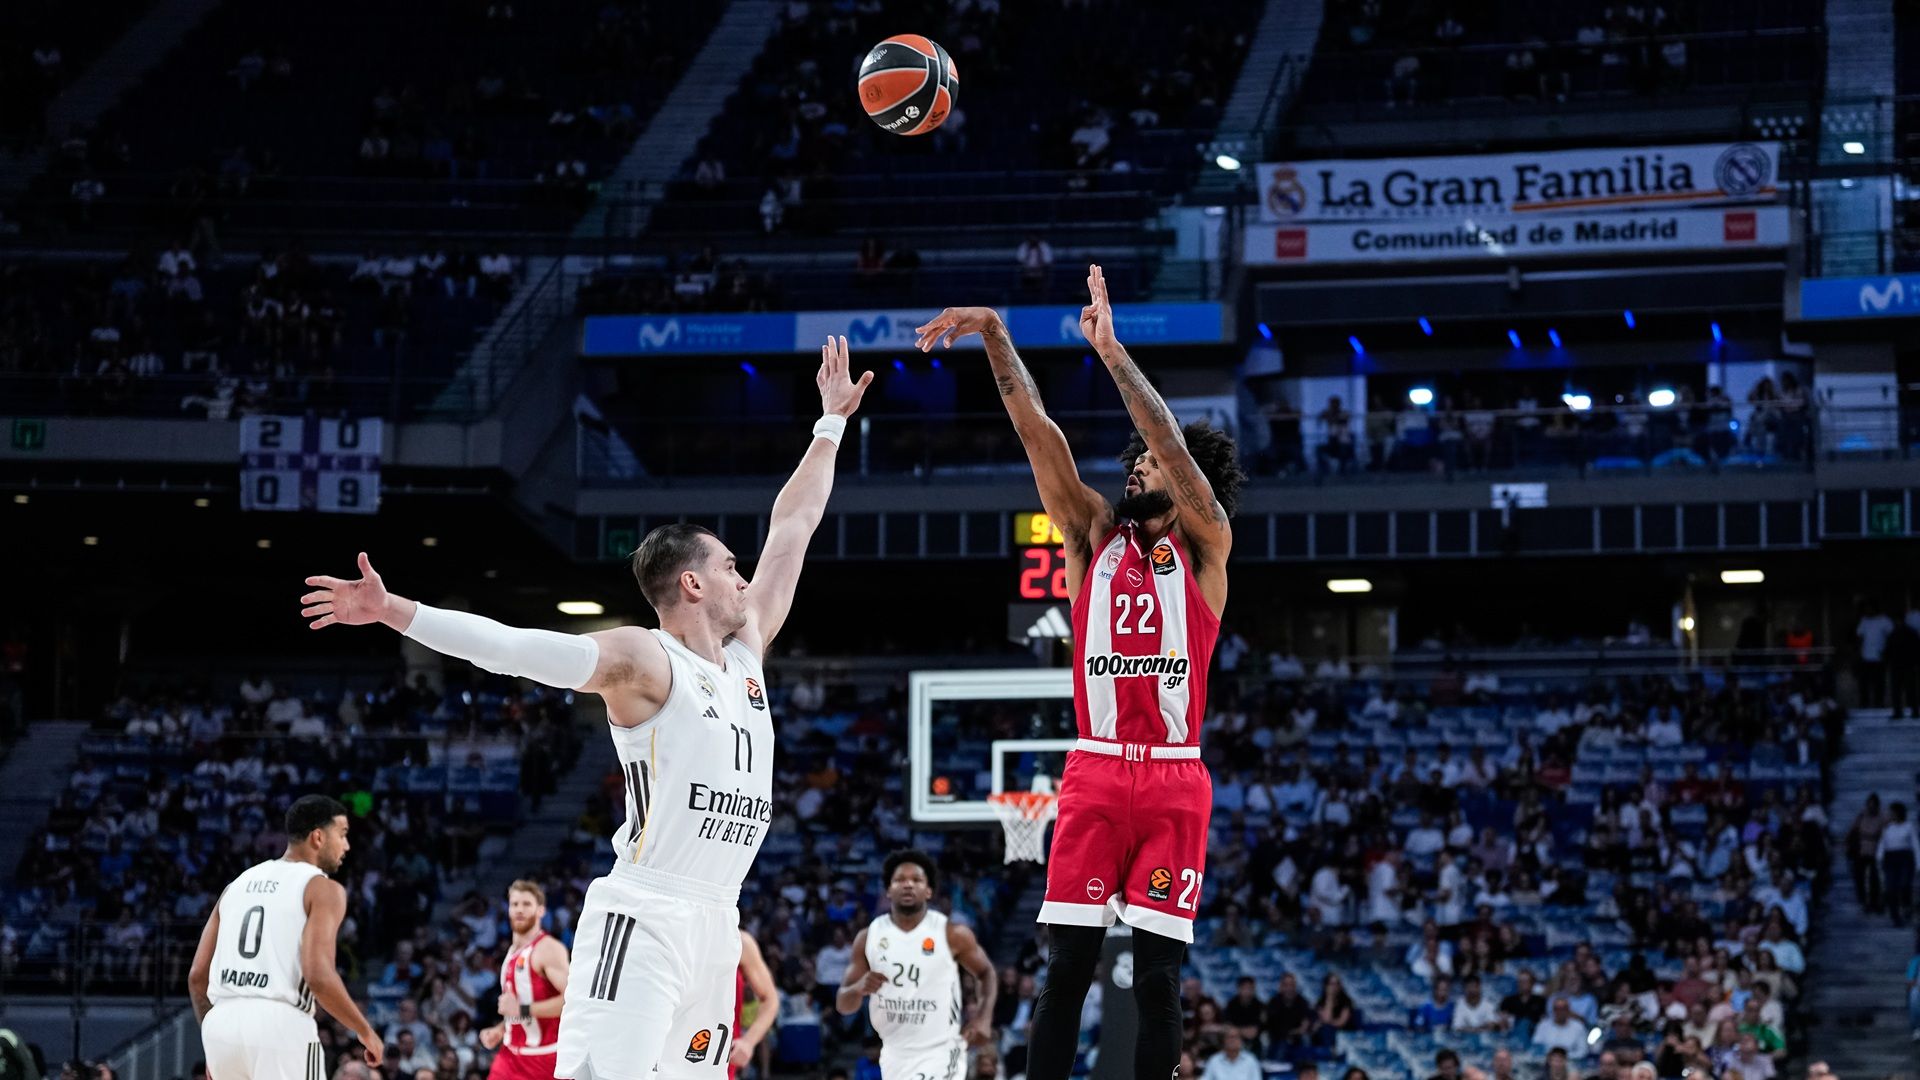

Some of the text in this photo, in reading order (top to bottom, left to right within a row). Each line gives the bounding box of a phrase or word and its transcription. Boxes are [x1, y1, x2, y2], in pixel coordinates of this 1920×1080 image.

[1318, 154, 1696, 208] La Gran Familia
[1528, 223, 1564, 244] de
[1574, 218, 1678, 242] Madrid
[259, 419, 360, 449] 2 0
[256, 474, 360, 508] 0 9
[1115, 593, 1156, 635] 22
[1086, 650, 1189, 677] 100xronia
[1163, 675, 1185, 690] .gr
[1125, 743, 1147, 762] OLY
[688, 782, 773, 824] Emirates
[698, 816, 724, 840] FLY
[246, 879, 280, 894] LYLES
[238, 905, 265, 960] 0
[221, 967, 269, 989] MADRID
[892, 962, 920, 988] 24
[878, 993, 938, 1012] Emirates
[712, 1023, 733, 1066] 1
